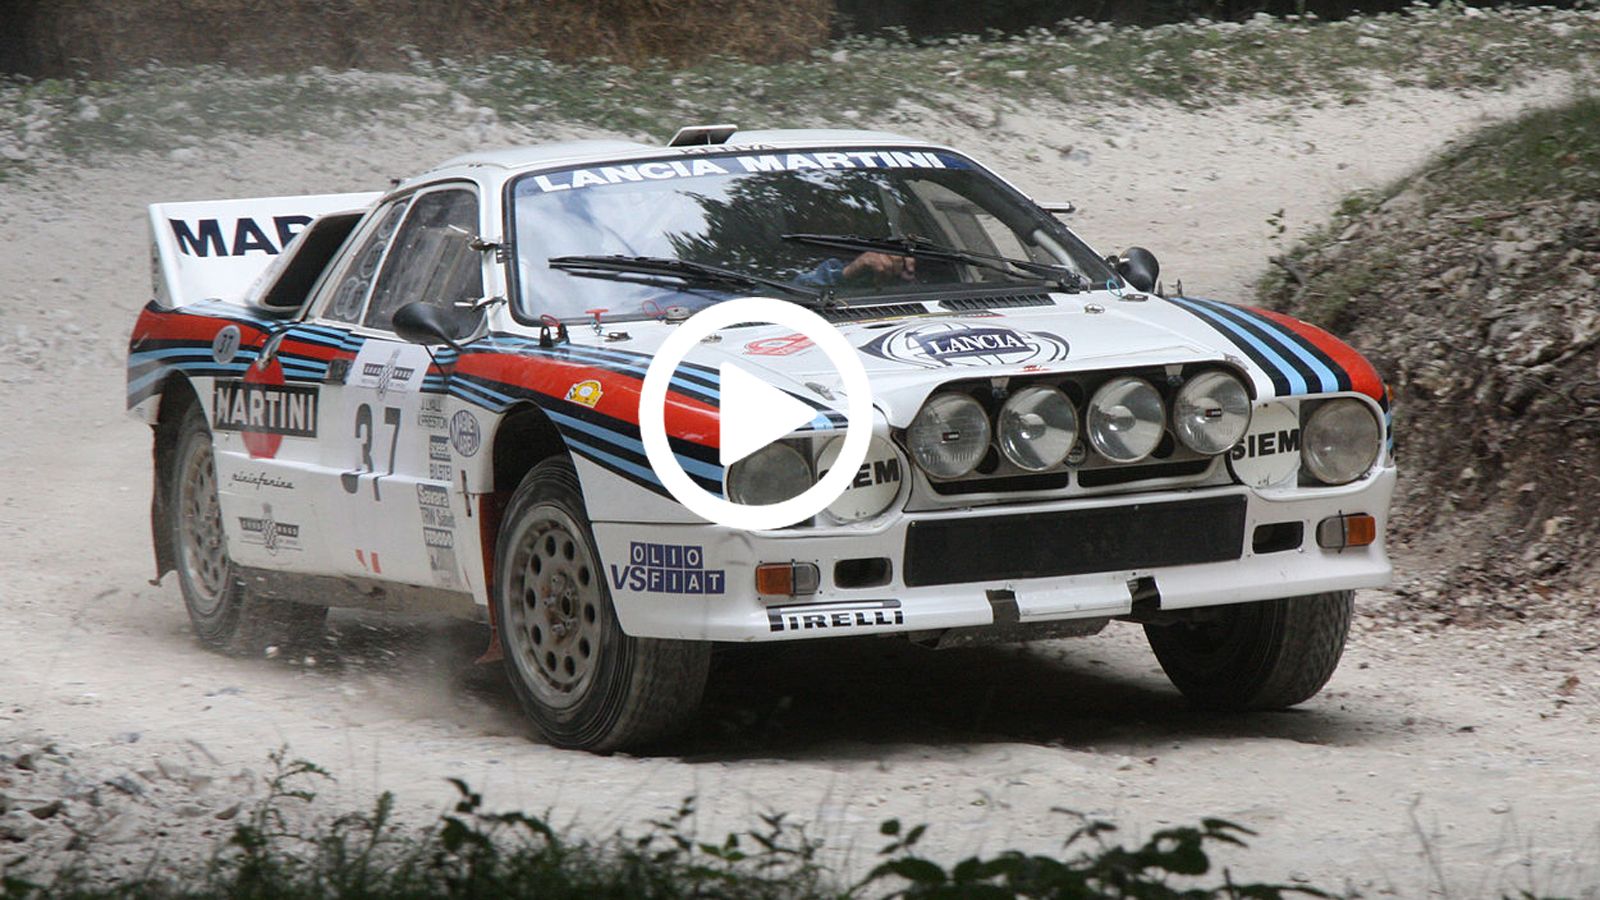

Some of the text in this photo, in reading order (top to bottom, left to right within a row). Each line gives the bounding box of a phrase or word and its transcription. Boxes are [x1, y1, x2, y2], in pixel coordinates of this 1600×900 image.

[534, 151, 947, 193] LANCIA MARTINI
[928, 334, 1025, 356] LANCIA
[215, 387, 314, 433] MARTINI
[341, 403, 401, 501] 37
[633, 543, 700, 566] OLIO
[611, 564, 646, 592] VS
[767, 600, 903, 632] PIRELLI
